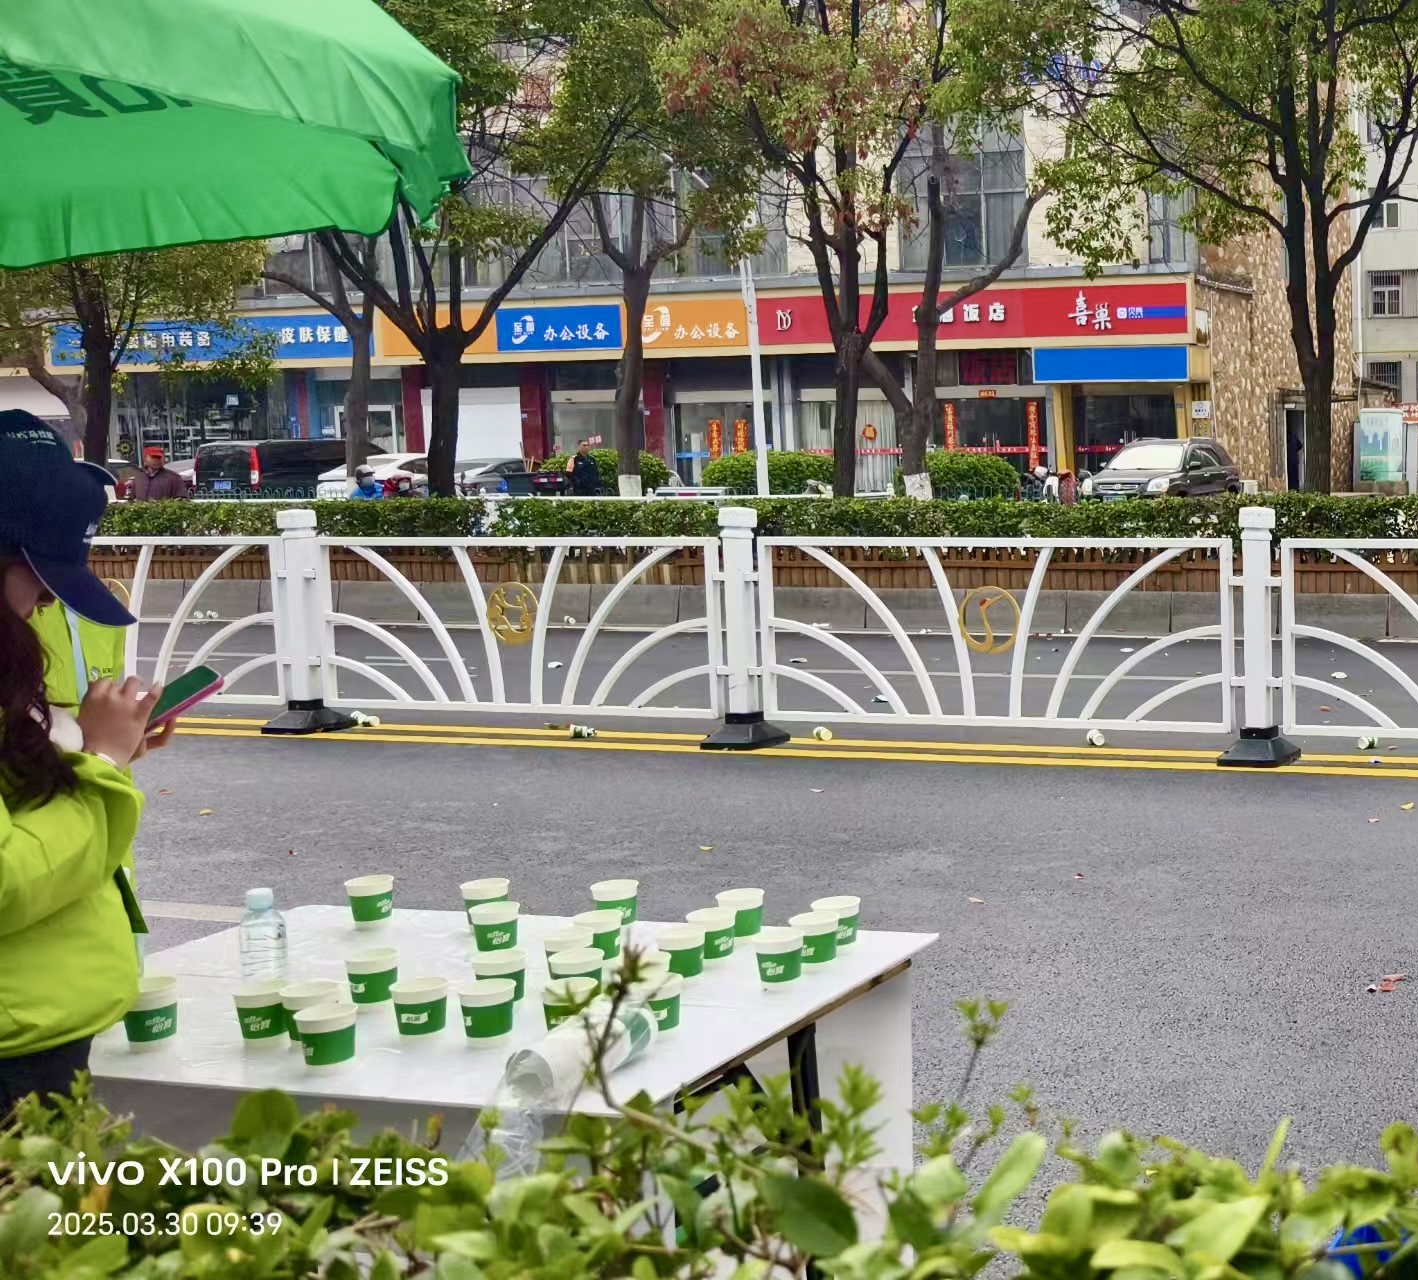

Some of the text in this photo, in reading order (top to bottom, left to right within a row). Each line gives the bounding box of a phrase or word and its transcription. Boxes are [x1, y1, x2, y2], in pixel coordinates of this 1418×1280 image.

[911, 302, 1005, 323] 饭店
[1068, 290, 1113, 331] 喜巢
[543, 322, 610, 341] 办公设备
[674, 323, 740, 340] 办公设备
